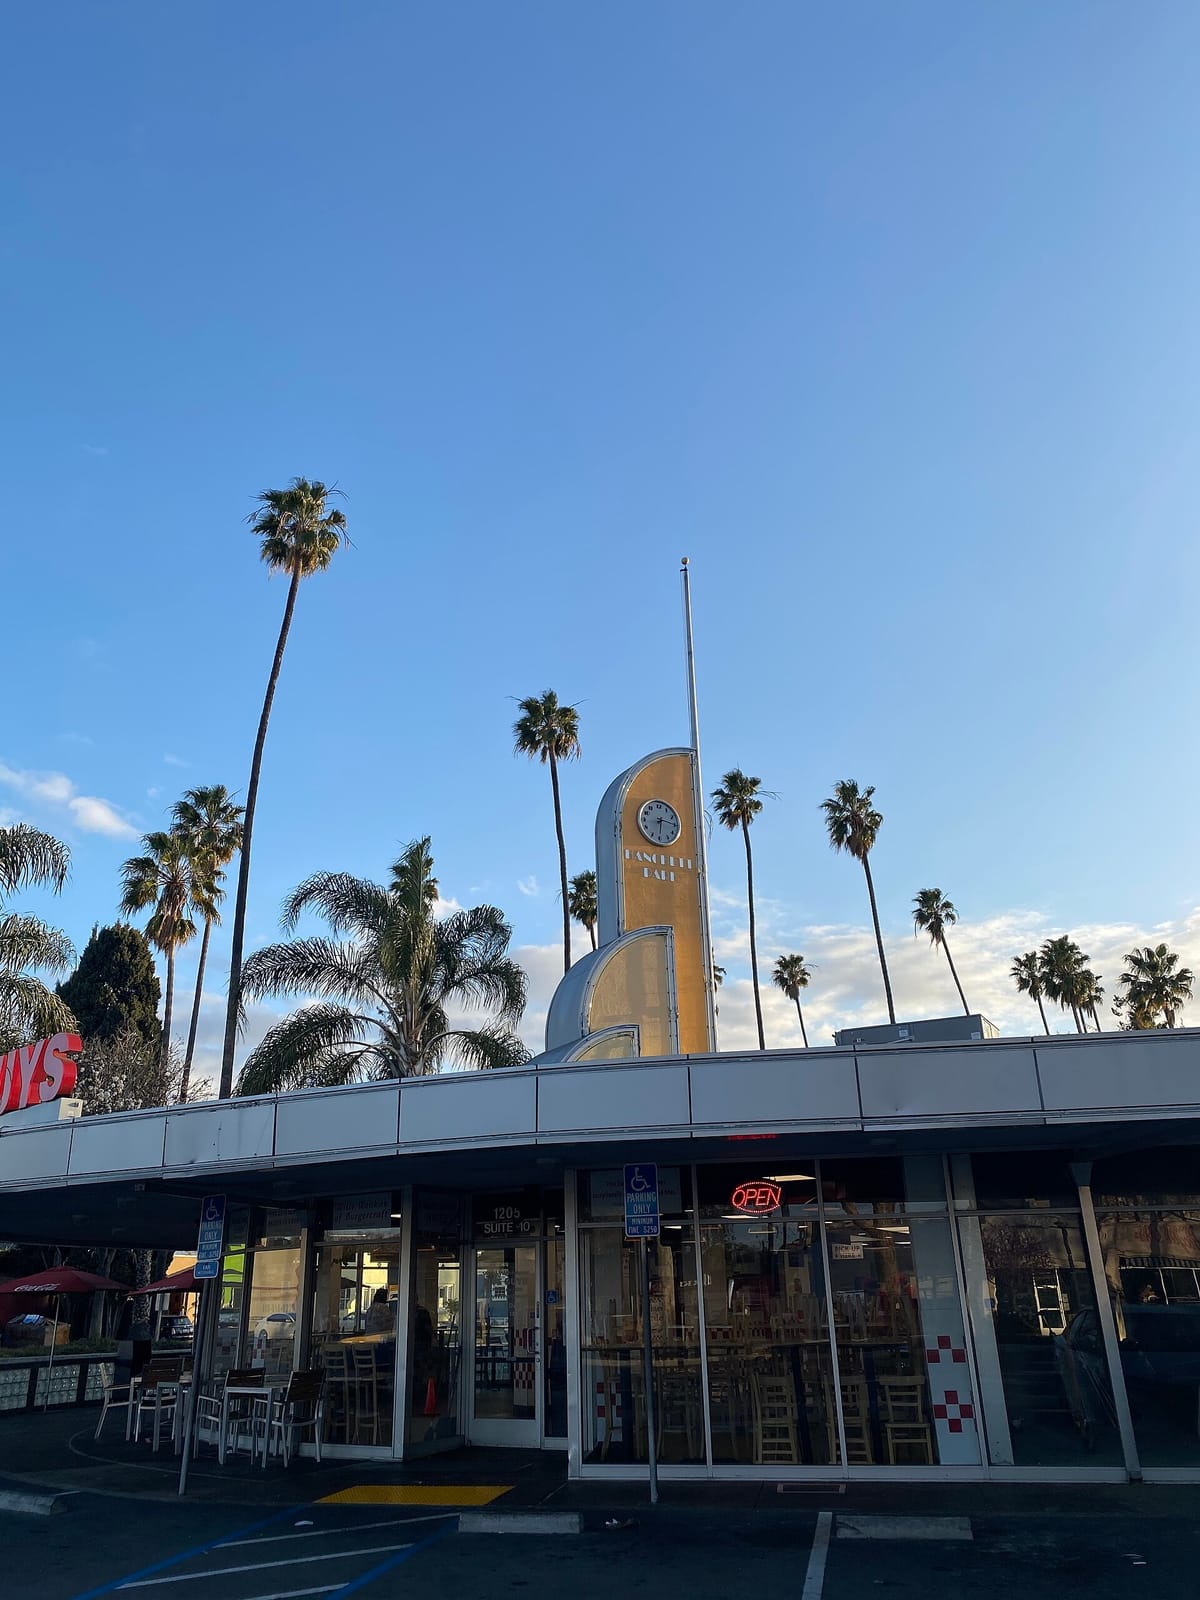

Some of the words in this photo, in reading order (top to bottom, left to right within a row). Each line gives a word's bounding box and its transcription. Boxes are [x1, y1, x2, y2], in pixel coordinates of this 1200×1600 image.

[627, 1192, 656, 1202] PARKING
[732, 1187, 781, 1208] OPEN
[494, 1206, 520, 1220] 1205
[633, 1204, 651, 1214] ONLY
[484, 1222, 513, 1234] SUITE
